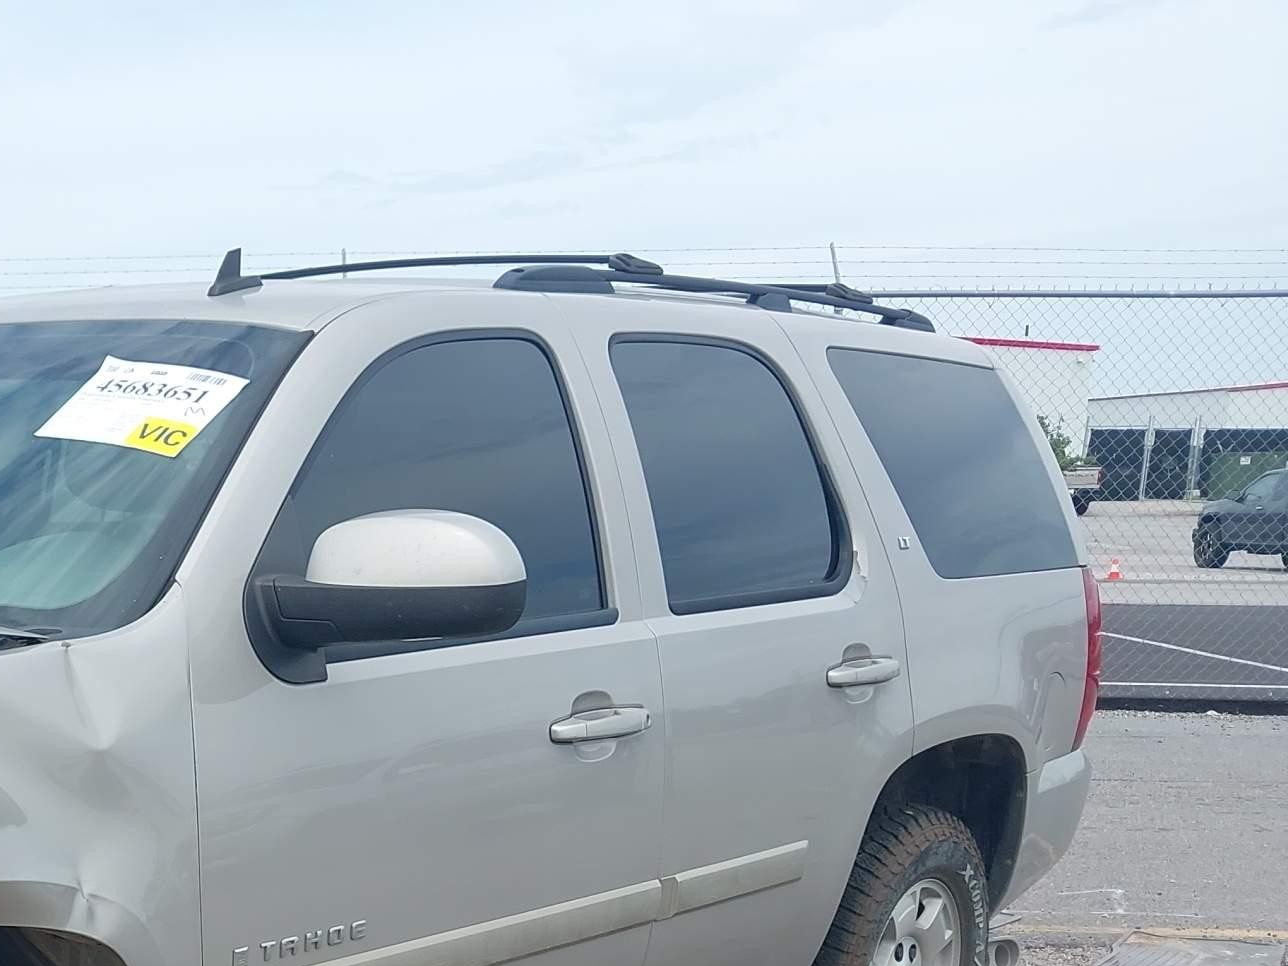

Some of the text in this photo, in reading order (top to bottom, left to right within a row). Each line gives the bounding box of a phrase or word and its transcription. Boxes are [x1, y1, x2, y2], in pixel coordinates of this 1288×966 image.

[96, 378, 209, 403] 45683651
[138, 422, 188, 447] VIC
[897, 535, 911, 551] LT
[259, 919, 367, 962] TAHOE
